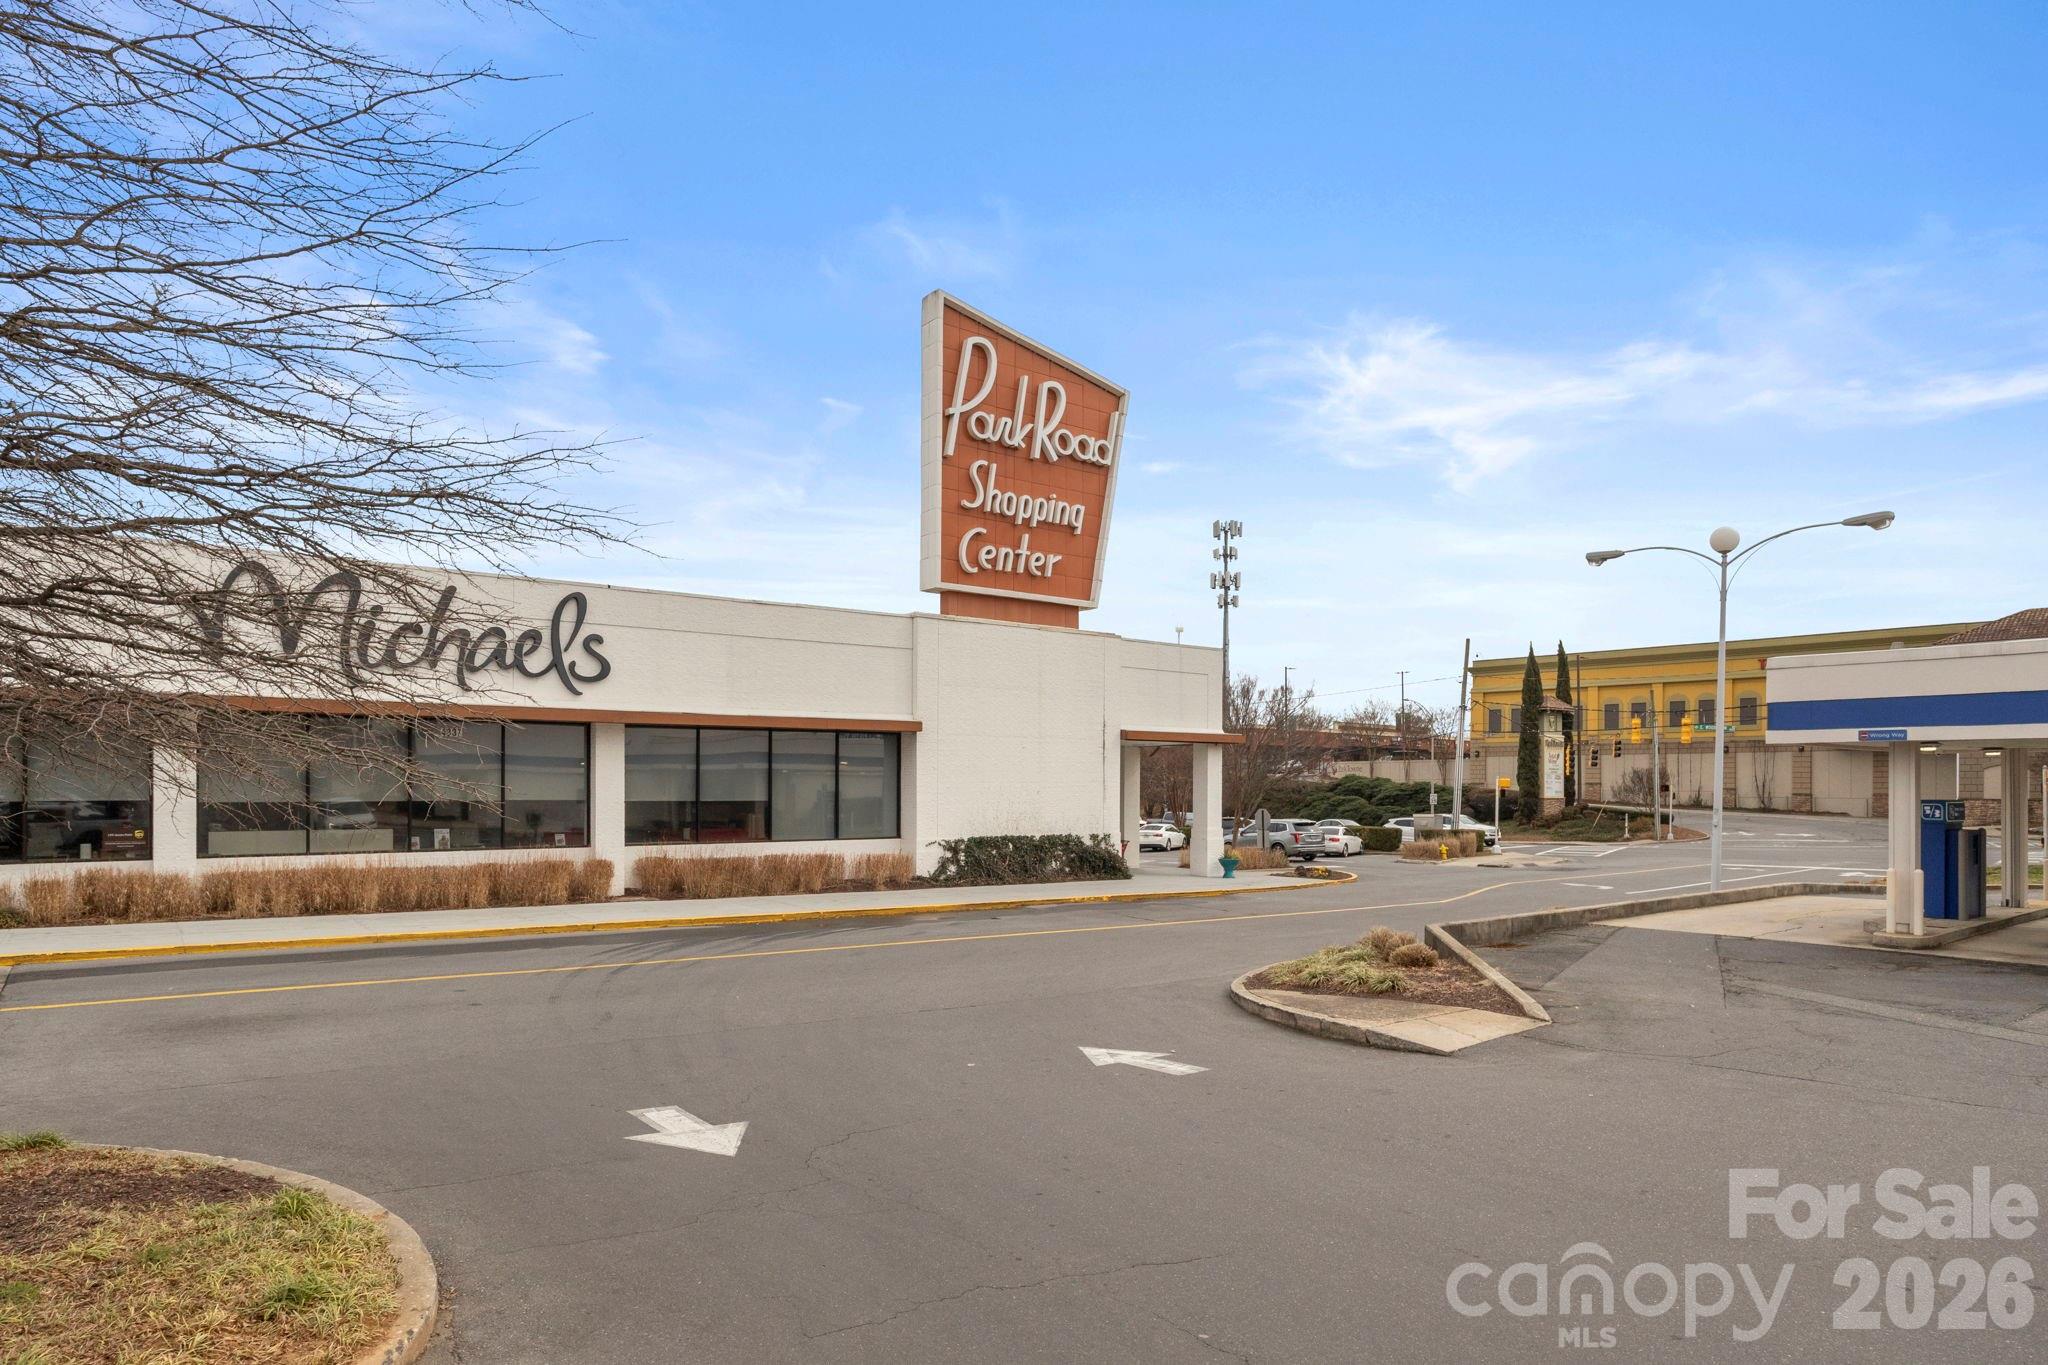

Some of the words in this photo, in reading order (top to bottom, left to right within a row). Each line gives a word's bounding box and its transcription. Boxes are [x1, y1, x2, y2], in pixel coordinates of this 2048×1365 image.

[943, 336, 1033, 458] Park
[1030, 381, 1119, 466] Road
[961, 460, 1085, 534] Shopping
[959, 527, 1062, 577] Center
[191, 561, 611, 695] Michaels
